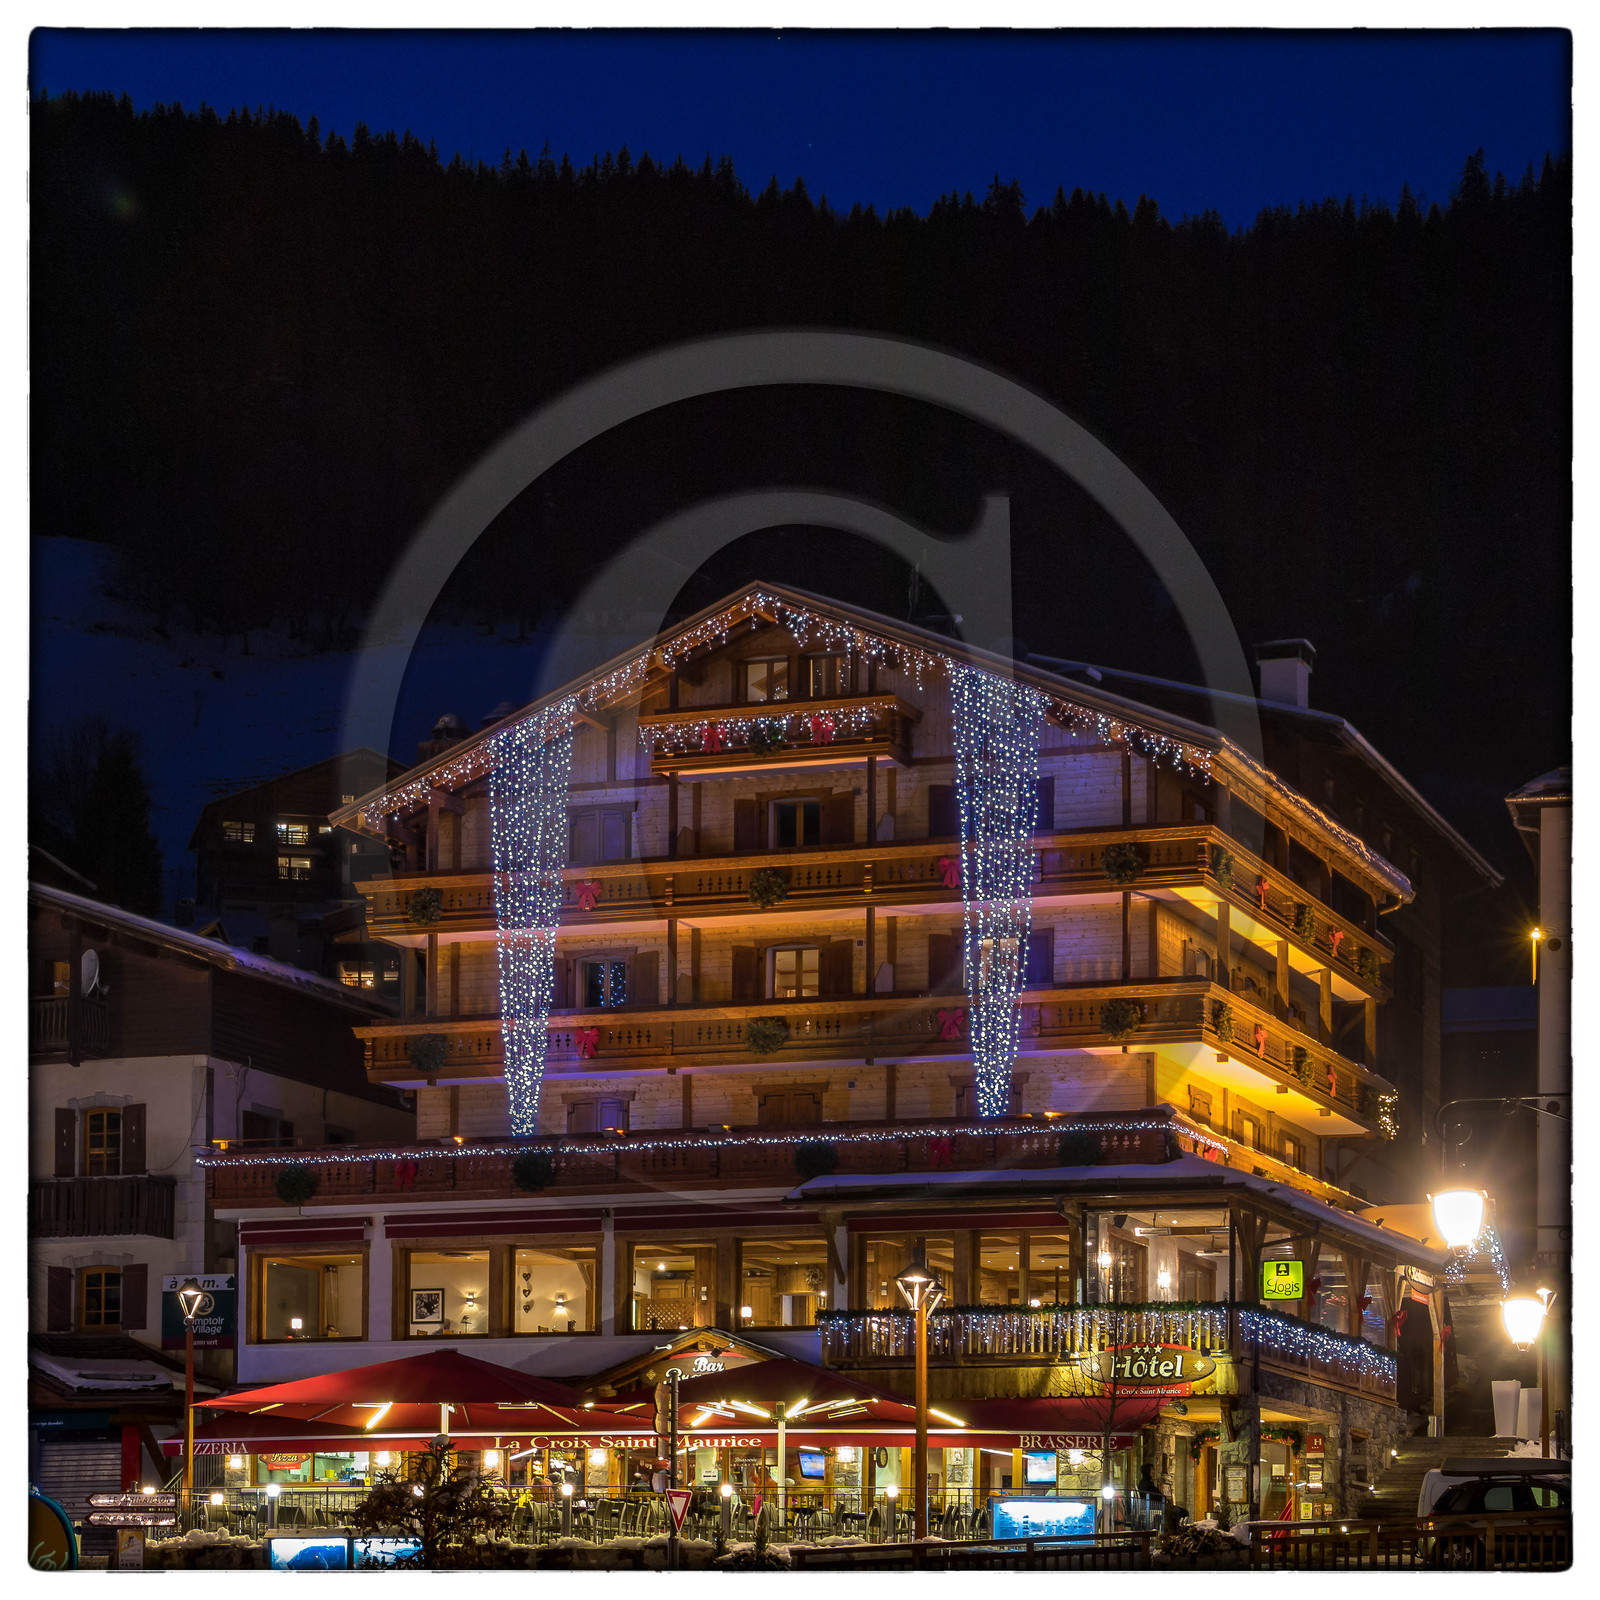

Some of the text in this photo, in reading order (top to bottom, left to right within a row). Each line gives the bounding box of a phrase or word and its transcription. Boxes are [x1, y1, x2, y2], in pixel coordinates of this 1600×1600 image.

[169, 1276, 178, 1289] à
[1265, 1279, 1300, 1296] Logis
[191, 1325, 222, 1335] Village
[692, 1356, 725, 1373] Bar
[1110, 1354, 1184, 1378] Hôtel
[1121, 1387, 1138, 1395] Croix
[1140, 1387, 1156, 1395] Saint
[1157, 1387, 1182, 1395] Maurice
[494, 1434, 762, 1450] La Croix Saint Maurice
[1019, 1434, 1118, 1450] BRASSERIE
[1314, 1438, 1322, 1446] H
[270, 1453, 298, 1462] Pizza
